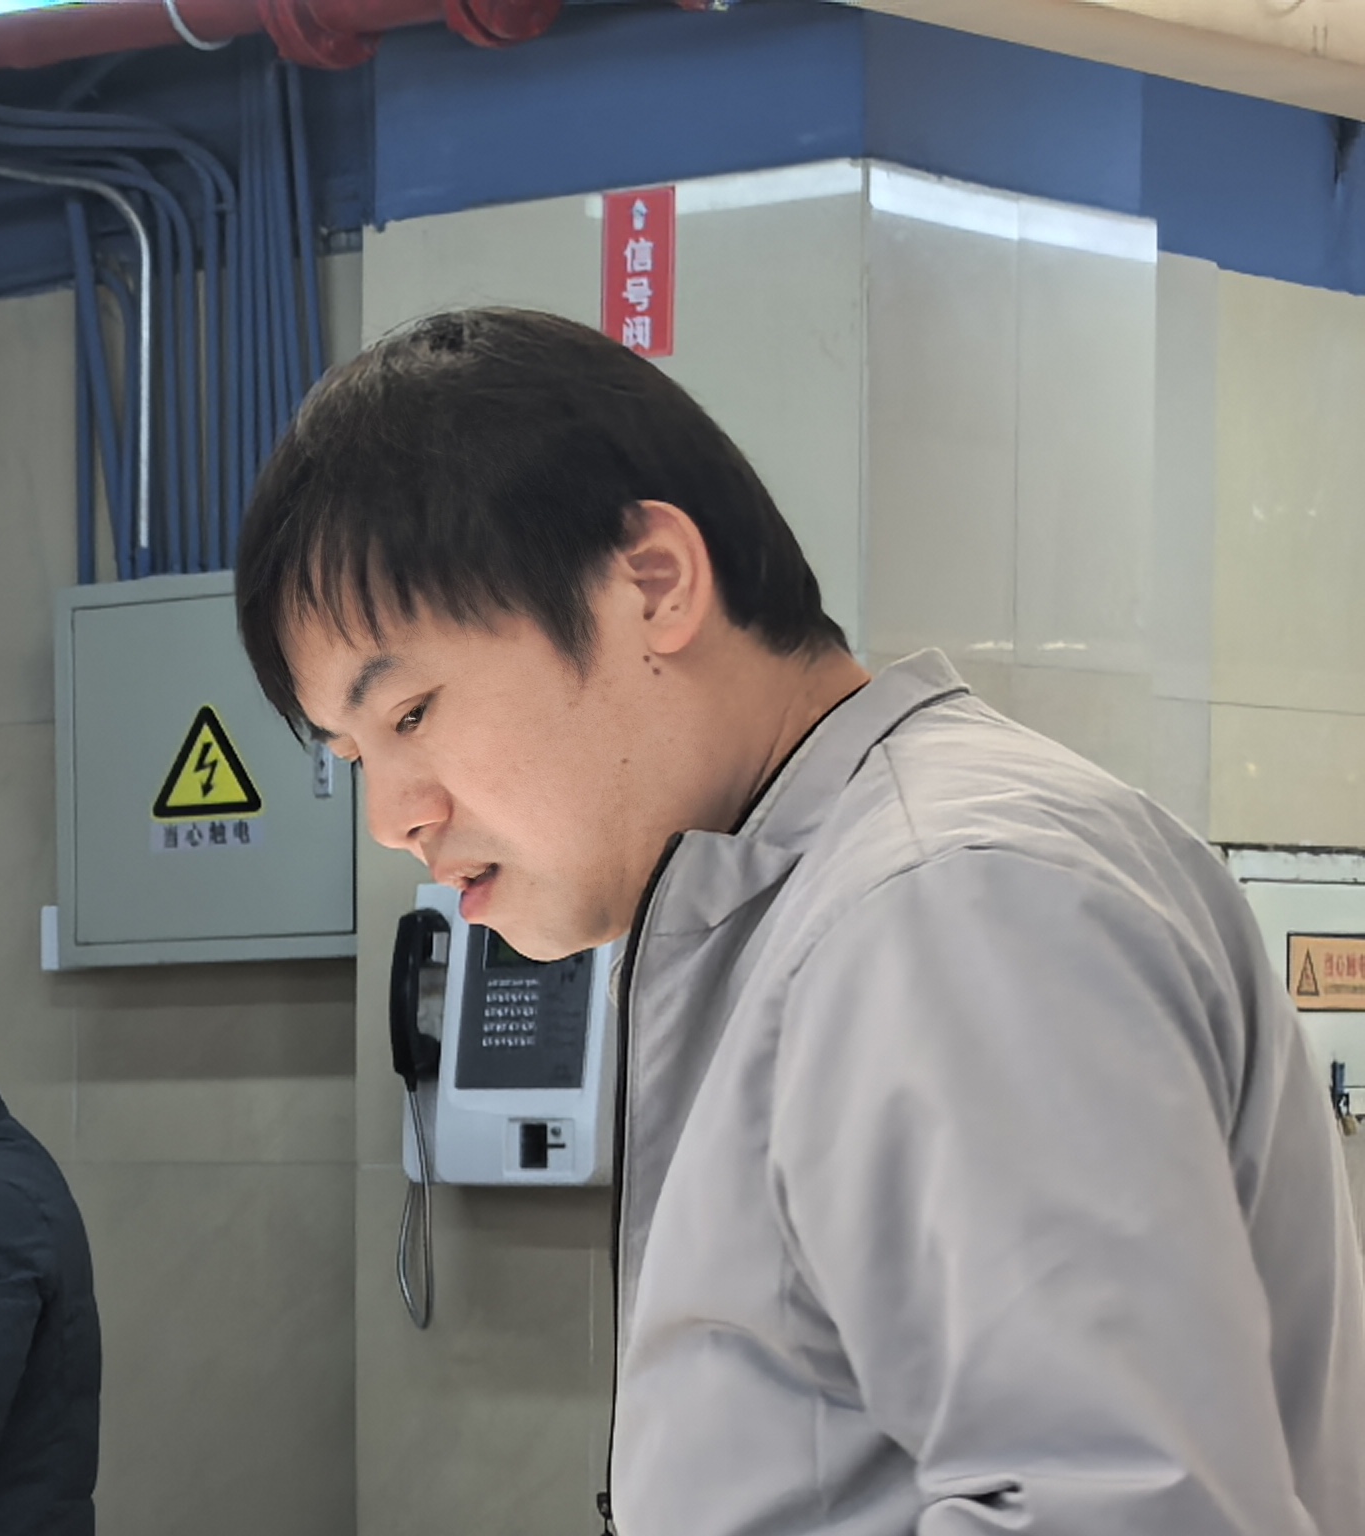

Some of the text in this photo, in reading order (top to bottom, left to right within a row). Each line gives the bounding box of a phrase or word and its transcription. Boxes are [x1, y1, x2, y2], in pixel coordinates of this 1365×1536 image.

[622, 237, 654, 351] 信号阀
[163, 820, 251, 849] 当心触电
